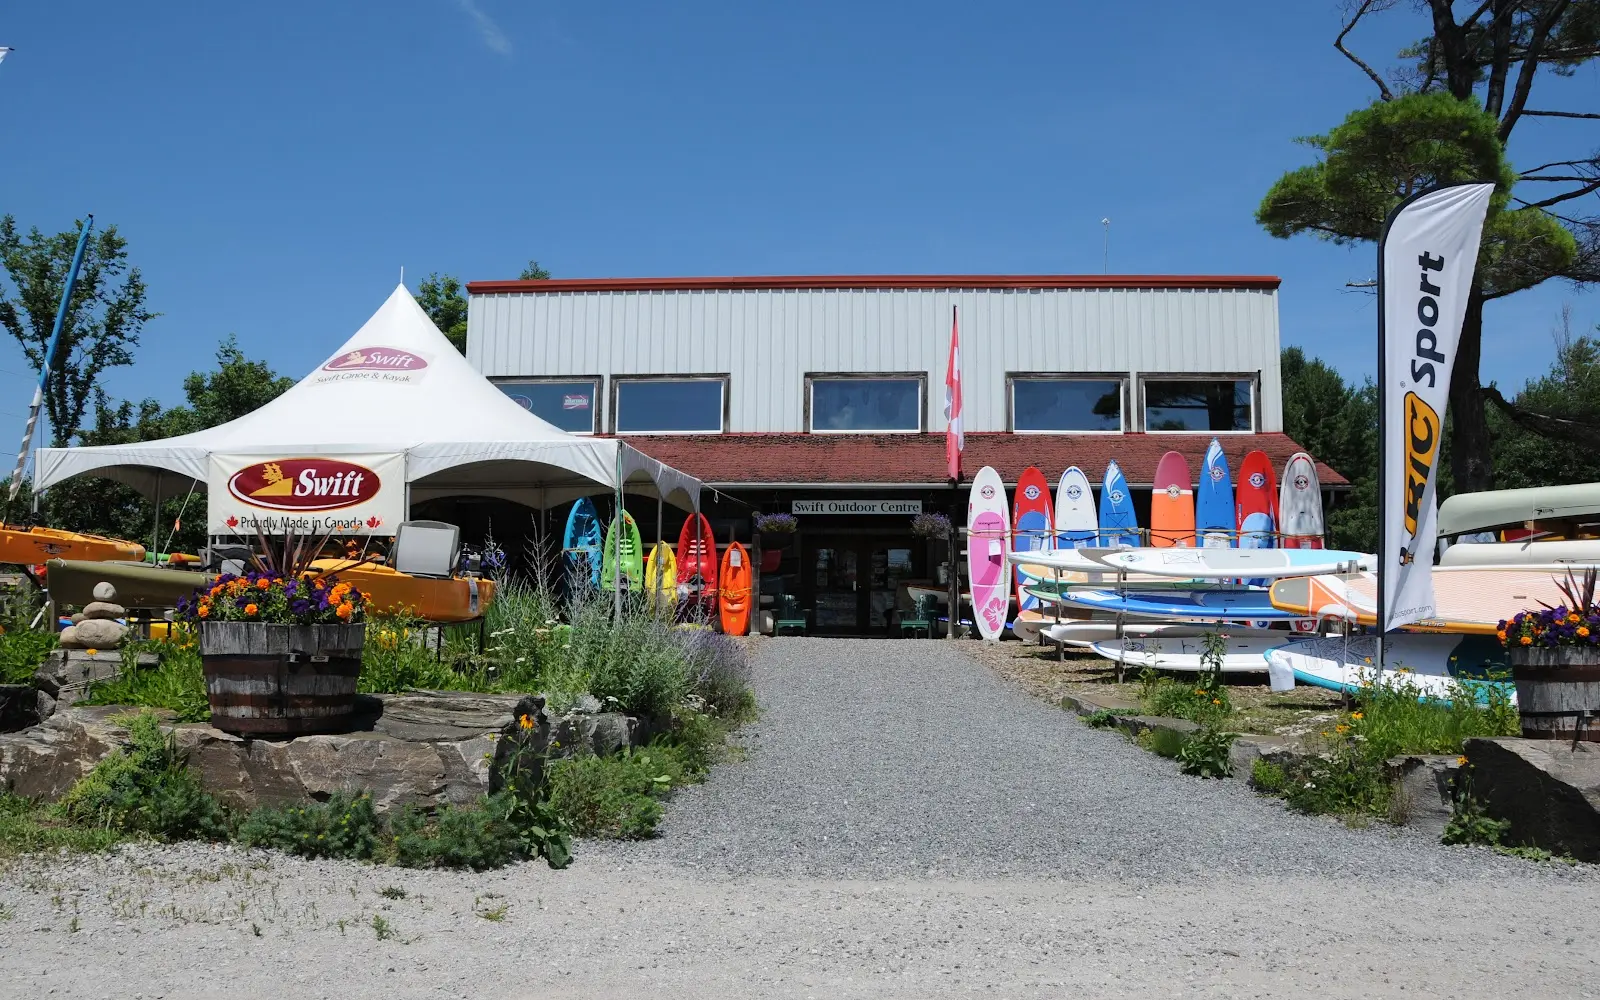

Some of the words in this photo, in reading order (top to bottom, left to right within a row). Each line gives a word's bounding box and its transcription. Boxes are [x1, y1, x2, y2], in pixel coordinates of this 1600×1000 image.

[1411, 251, 1446, 388] Sport
[365, 352, 415, 367] Swift
[316, 373, 340, 384] Swift
[341, 372, 370, 380] Canoe
[382, 373, 412, 382] Kayak
[1406, 399, 1433, 521] BIC
[294, 468, 364, 496] Swift
[794, 501, 824, 512] Swift
[828, 501, 877, 512] Outdoor
[880, 501, 919, 512] Centre
[241, 516, 278, 530] Proudly
[280, 516, 307, 529] Made
[312, 516, 321, 529] in
[324, 516, 363, 529] Canada
